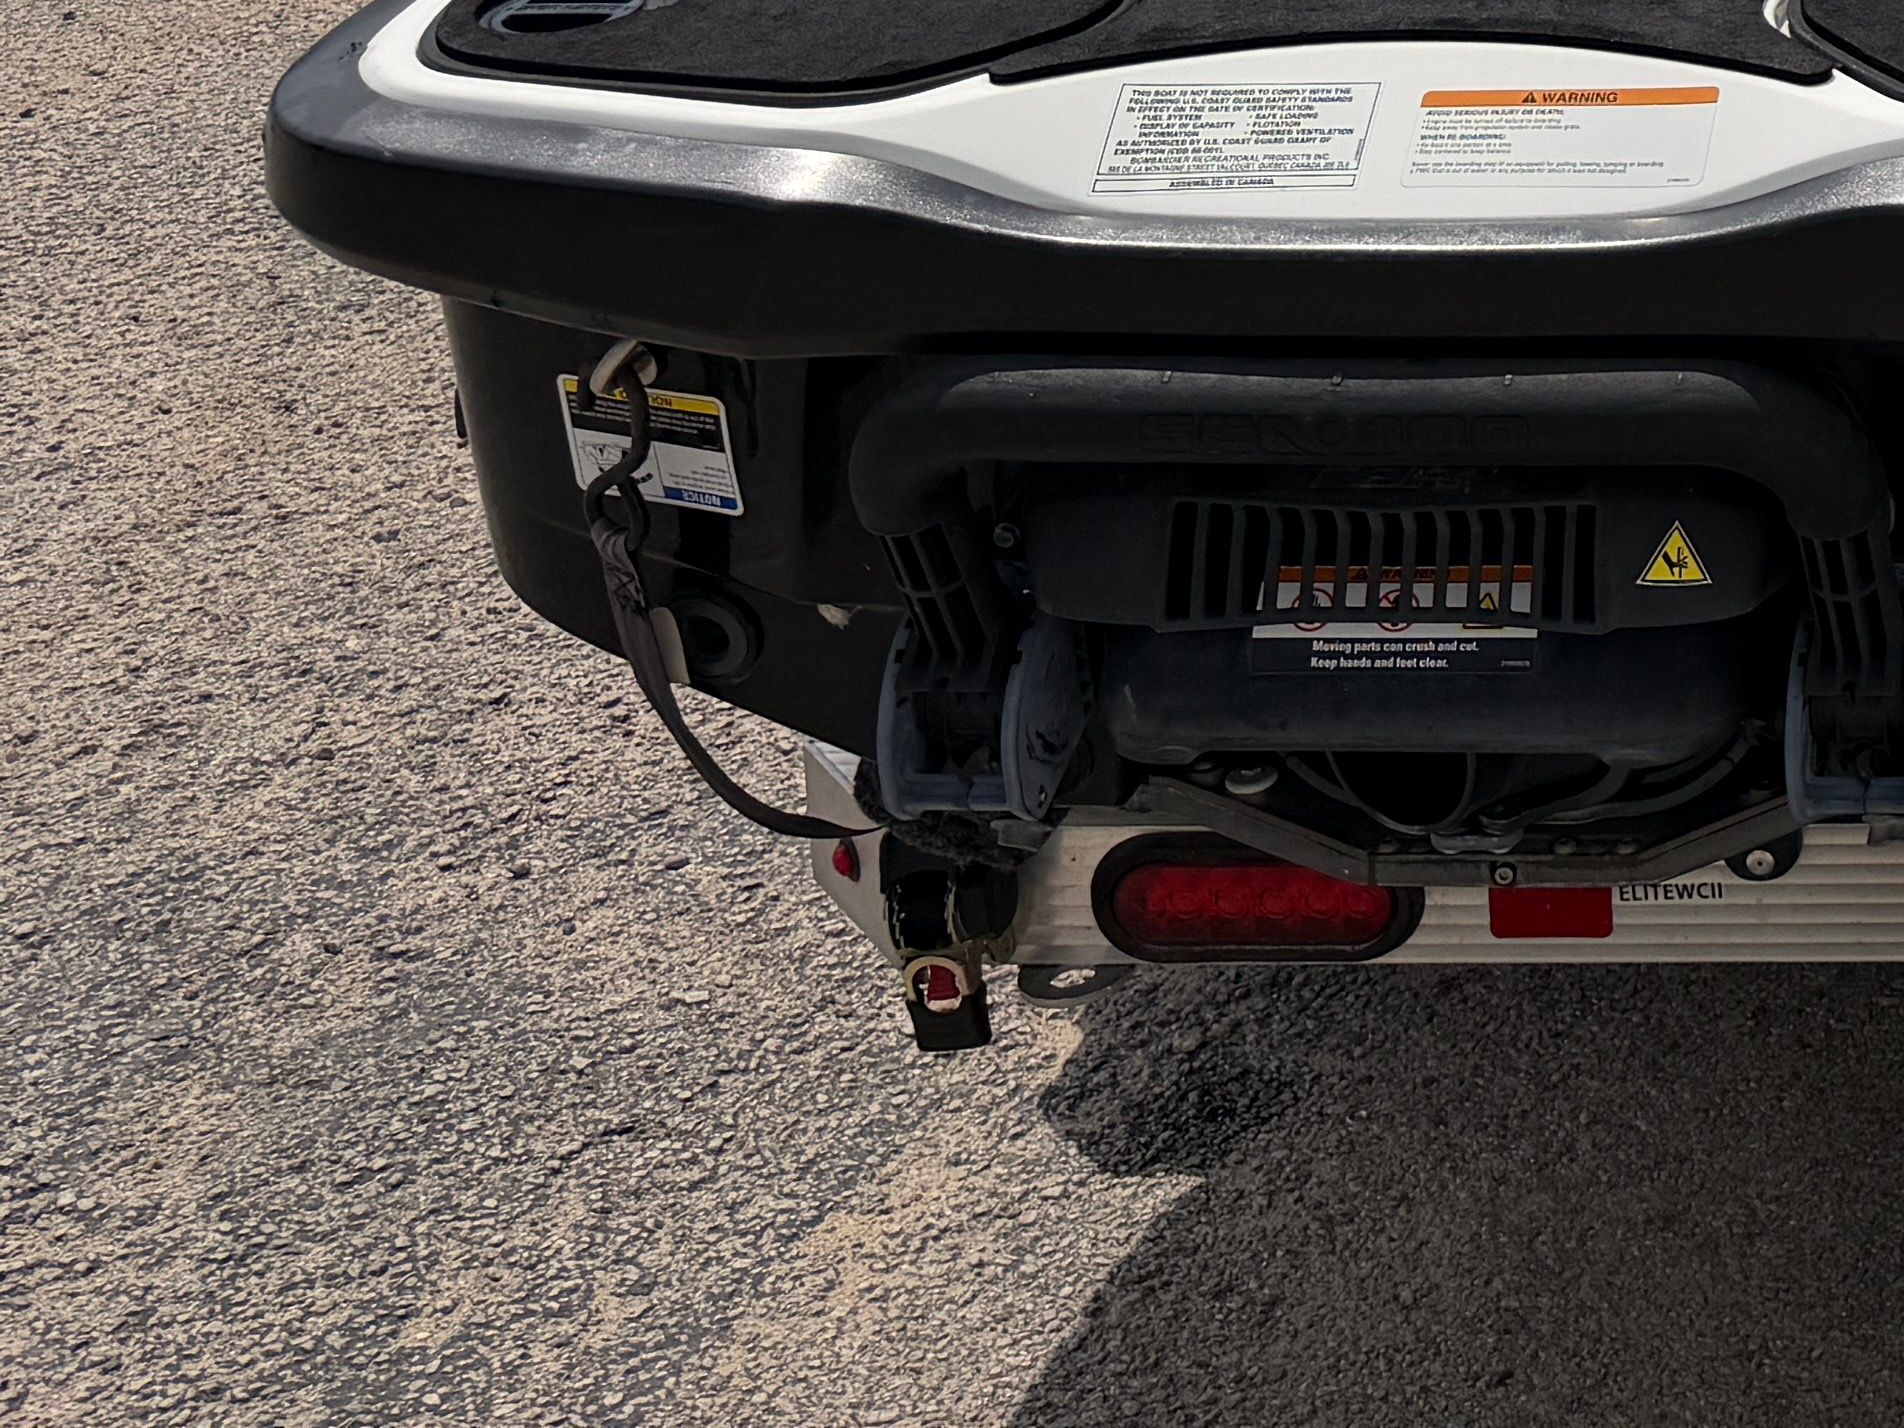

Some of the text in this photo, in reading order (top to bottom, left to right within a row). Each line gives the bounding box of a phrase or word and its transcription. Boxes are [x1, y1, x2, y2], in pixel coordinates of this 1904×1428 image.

[1542, 91, 1619, 104] WARNING
[1312, 640, 1351, 655] Moving
[1354, 640, 1381, 654] parts
[1383, 642, 1403, 652] can
[1405, 640, 1435, 652] crush
[1438, 640, 1457, 652] and
[1311, 656, 1337, 670] Keep
[1339, 656, 1371, 669] hands
[1374, 656, 1394, 669] and
[1396, 656, 1417, 669] feet
[1619, 882, 1724, 902] ELITEWCII
